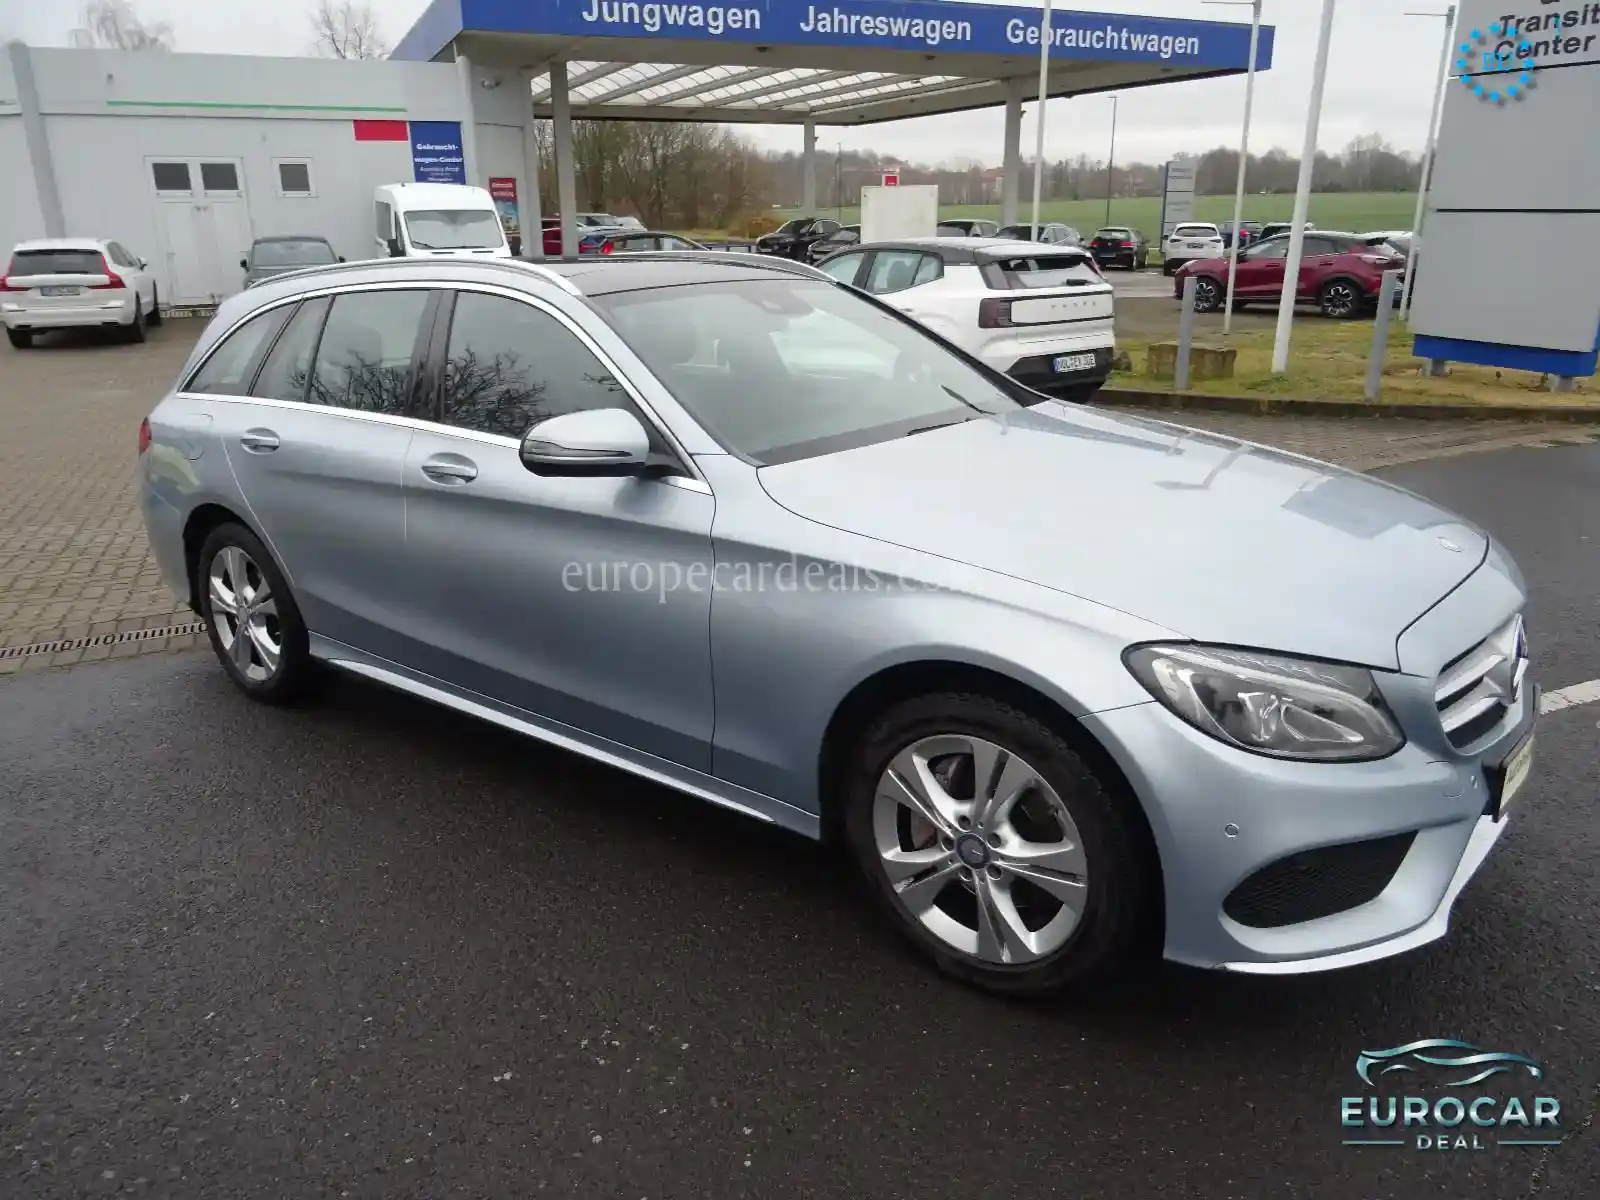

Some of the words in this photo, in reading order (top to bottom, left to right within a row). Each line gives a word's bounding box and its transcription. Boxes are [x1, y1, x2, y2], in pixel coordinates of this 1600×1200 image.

[582, 0, 761, 35] Jungwagen
[800, 5, 972, 45] Jahreswagen
[1006, 18, 1200, 59] Gebrauchtwagen
[1498, 2, 1600, 37] Transit
[1494, 34, 1597, 62] Center
